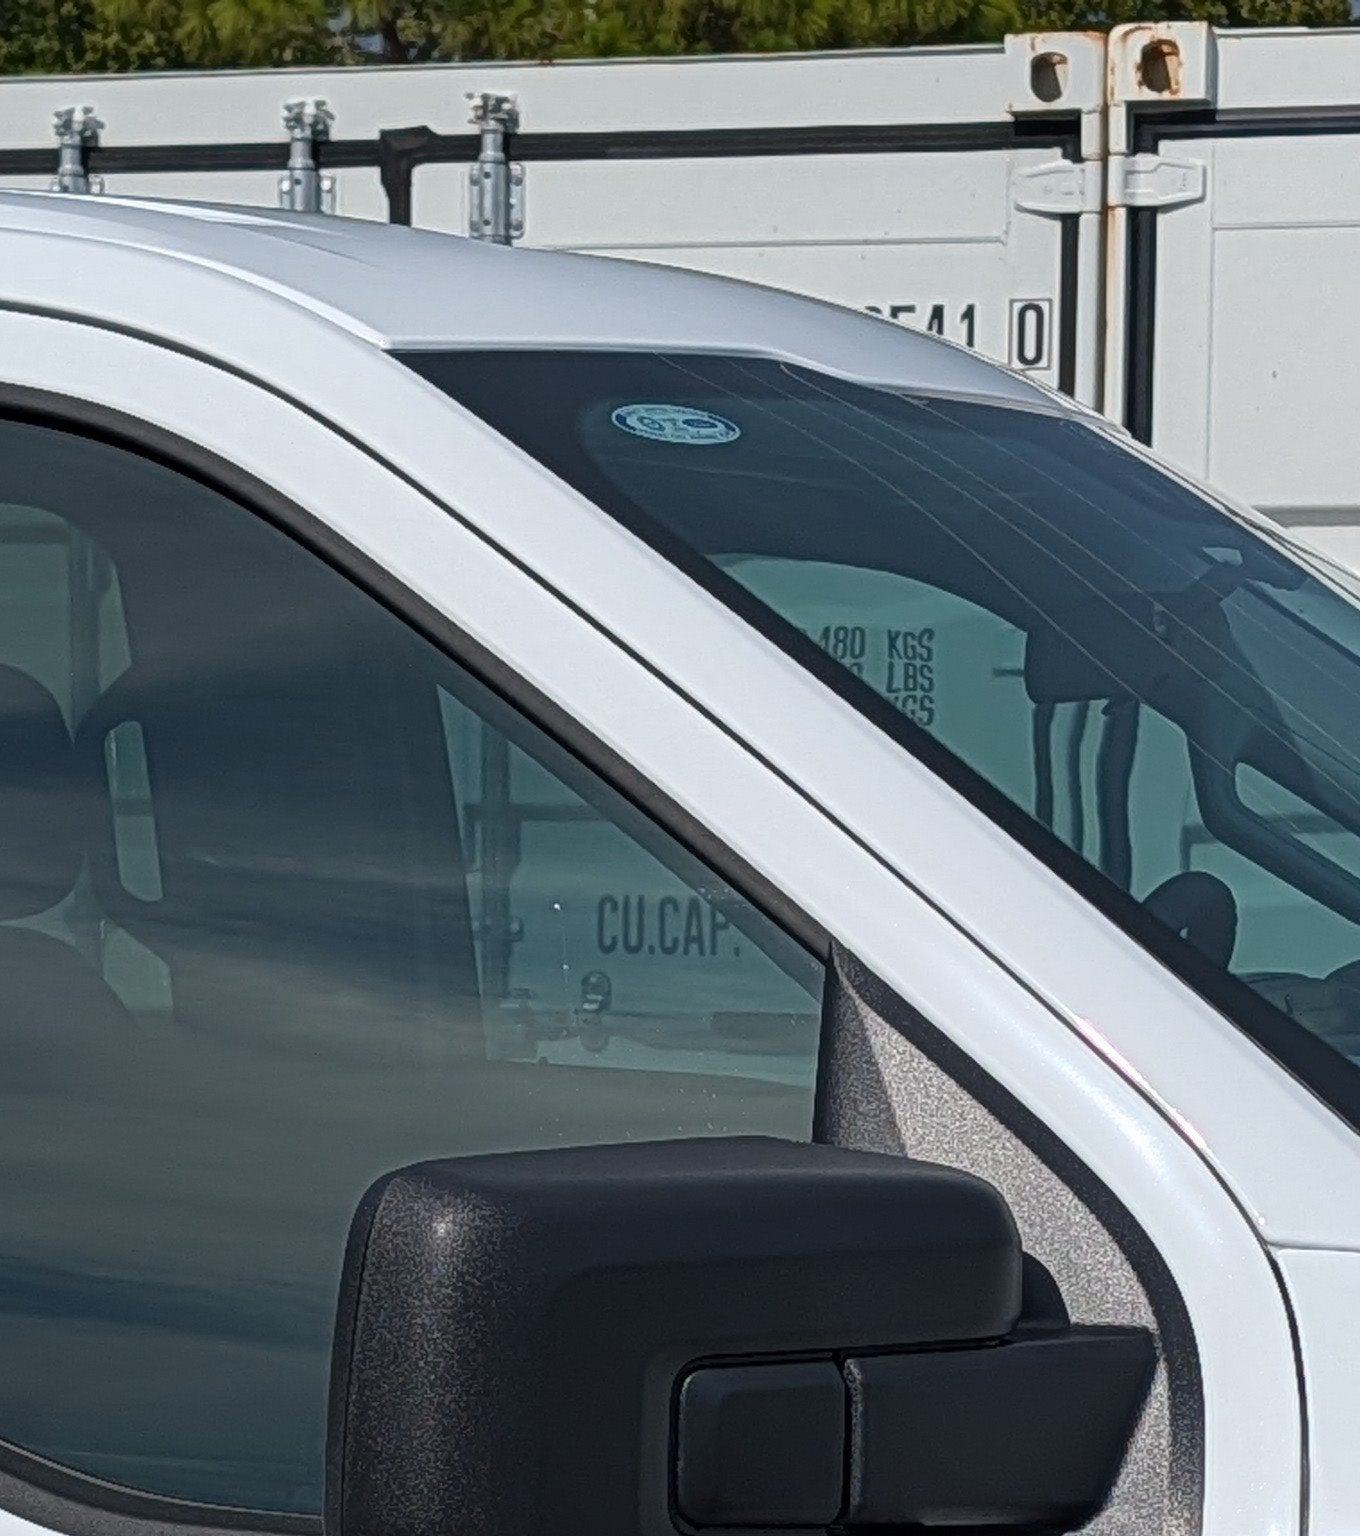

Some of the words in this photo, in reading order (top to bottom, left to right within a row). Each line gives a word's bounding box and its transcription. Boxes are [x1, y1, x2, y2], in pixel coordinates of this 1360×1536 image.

[886, 628, 936, 663] KGS
[886, 660, 936, 694] LBS
[891, 694, 936, 727] GS
